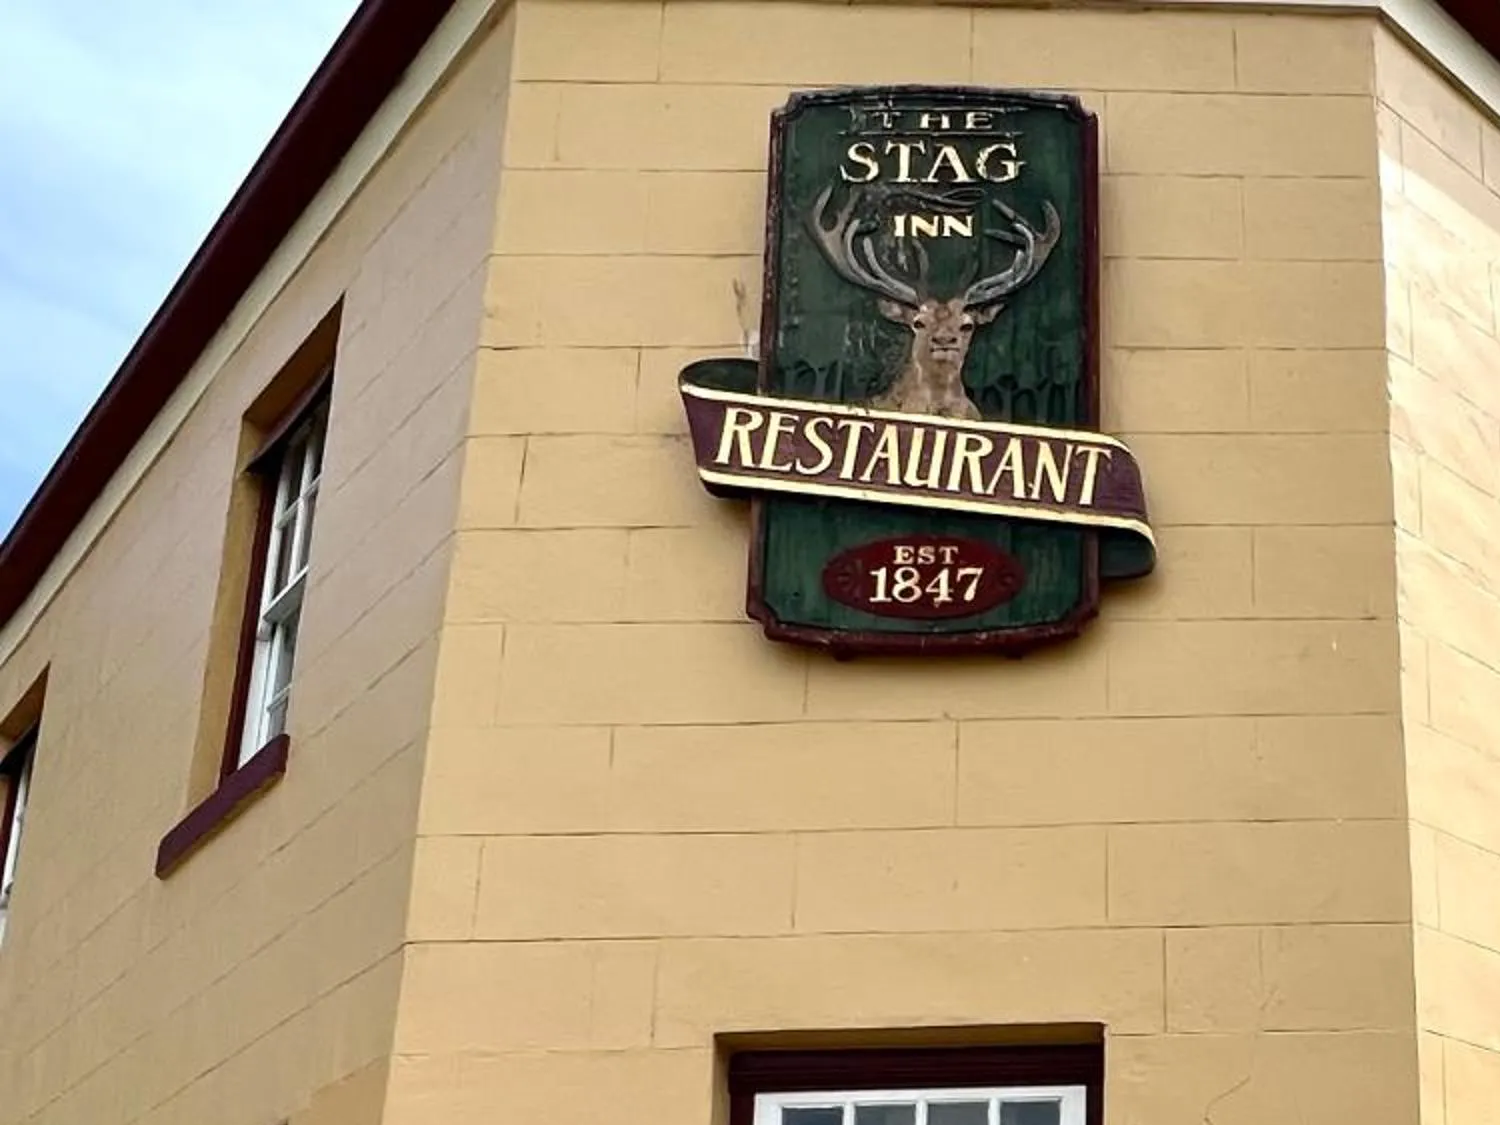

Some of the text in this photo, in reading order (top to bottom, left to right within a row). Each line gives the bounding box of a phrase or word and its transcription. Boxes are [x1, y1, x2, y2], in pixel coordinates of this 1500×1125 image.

[872, 111, 993, 129] THE
[840, 142, 1026, 183] STAG
[894, 215, 973, 237] INN
[716, 407, 1112, 505] RESTAURANT
[893, 545, 958, 565] EST
[869, 566, 983, 607] 1847
